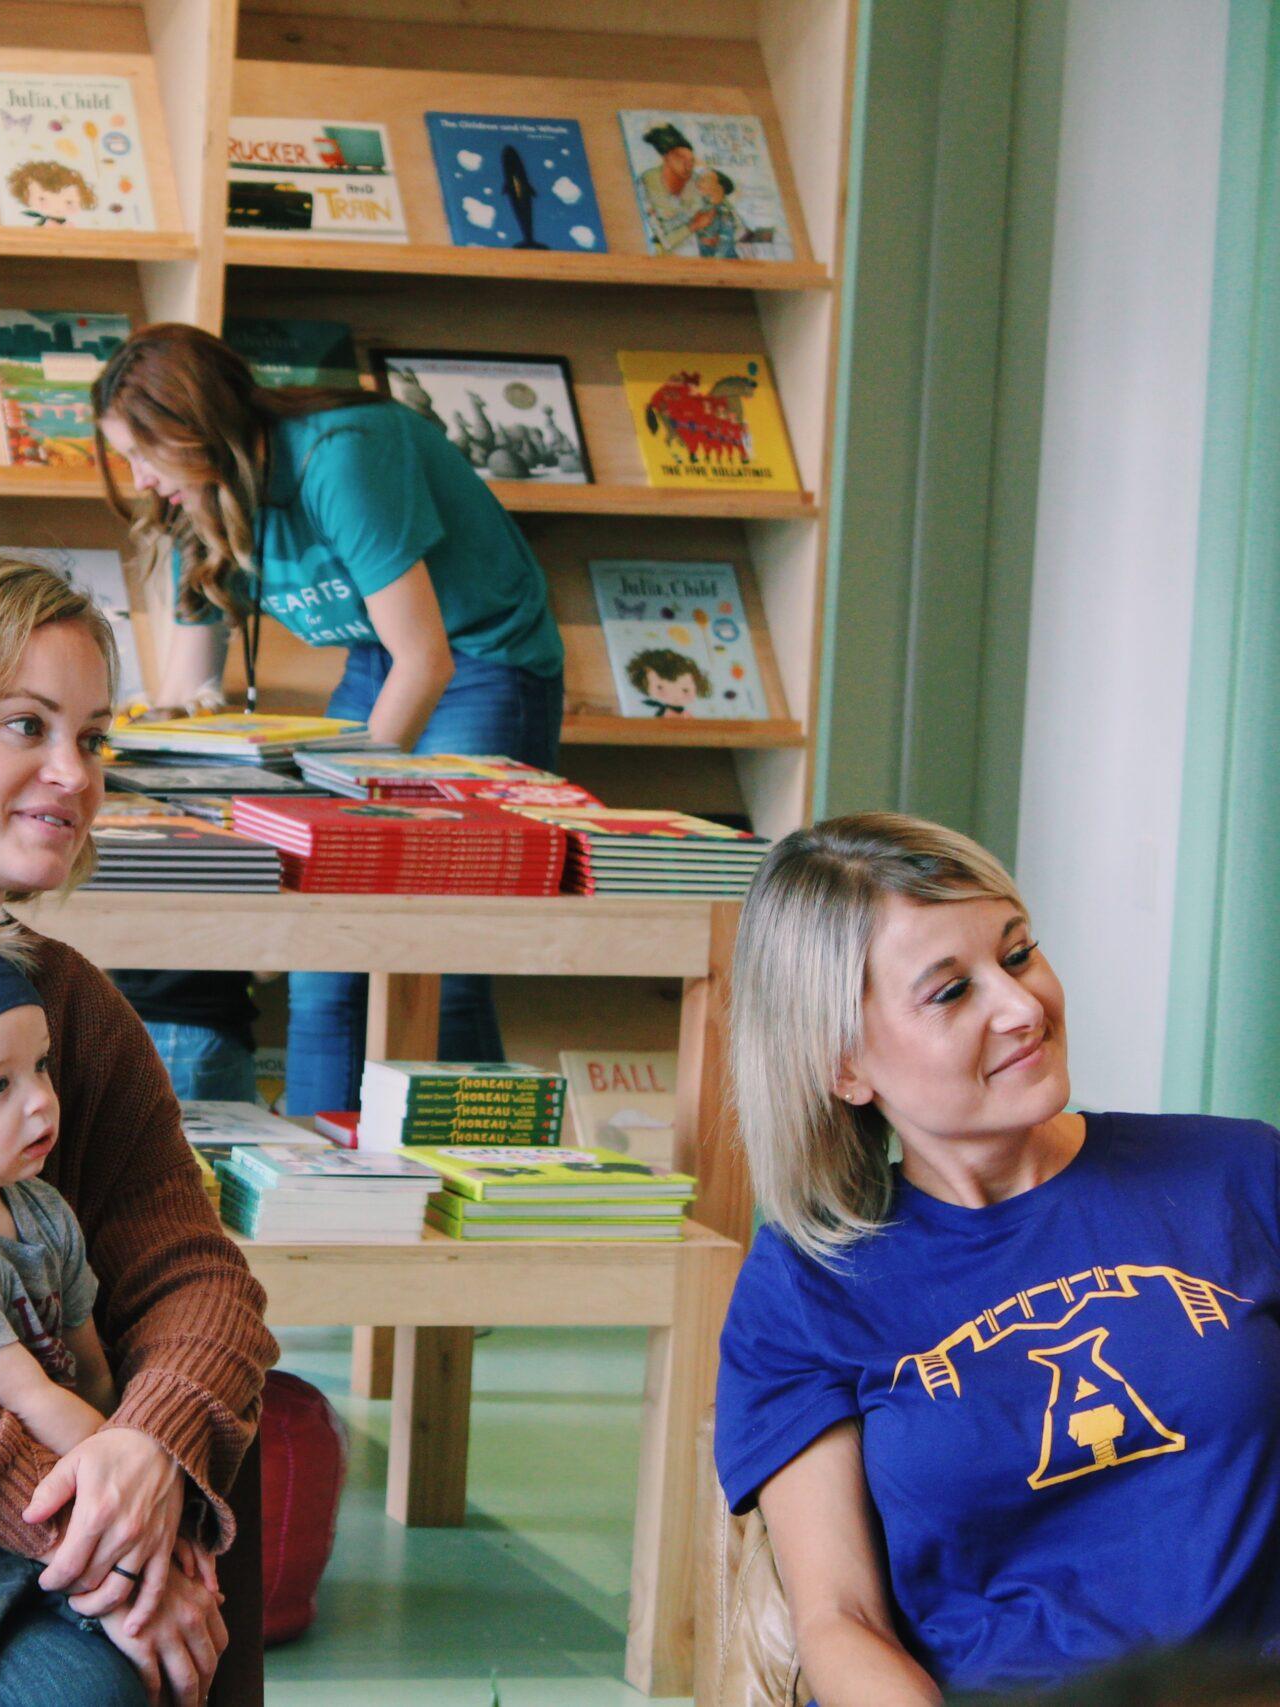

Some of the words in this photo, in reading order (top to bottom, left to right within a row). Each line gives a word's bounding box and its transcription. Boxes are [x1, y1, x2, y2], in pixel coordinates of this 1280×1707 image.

[61, 92, 112, 110] Child
[456, 1076, 513, 1091] THOREAU
[588, 1062, 668, 1093] BALL
[453, 1090, 510, 1104] THOREAU
[454, 1104, 510, 1117] THOREAU
[450, 1117, 507, 1130] THOREAU
[449, 1130, 506, 1144] THOREAU
